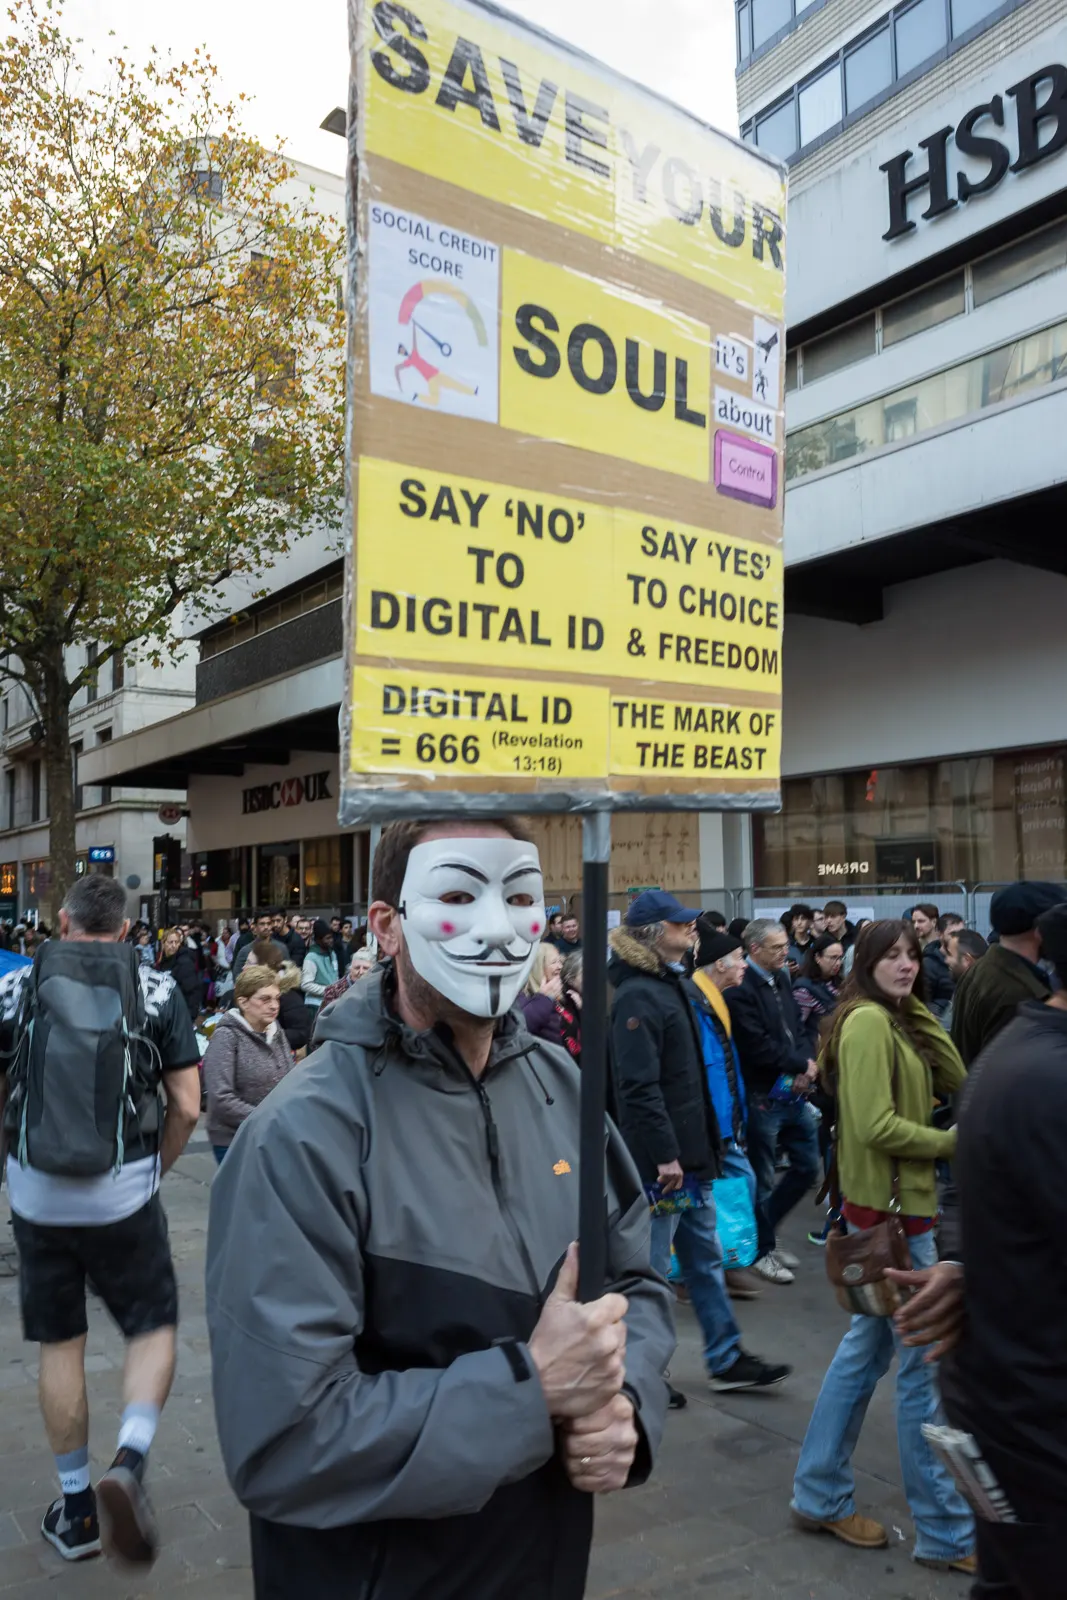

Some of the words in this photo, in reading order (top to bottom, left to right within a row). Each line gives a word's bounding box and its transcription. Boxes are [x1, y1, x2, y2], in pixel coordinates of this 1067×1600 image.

[371, 1, 611, 178] SAVE
[615, 125, 785, 272] YOUR
[372, 206, 434, 243] SOCIAL
[439, 229, 496, 262] CREDIT
[408, 248, 463, 280] SCORE
[512, 303, 706, 429] SOUL
[718, 396, 772, 436] about
[728, 458, 766, 483] Control
[399, 478, 490, 529] SAY
[640, 526, 698, 565] SAY
[467, 546, 525, 590] TO
[370, 590, 552, 647] DIGITAL
[568, 615, 605, 652] ID
[627, 573, 667, 609] TO
[679, 584, 778, 630] CHOICE
[626, 627, 646, 657] &
[659, 633, 779, 675] FREEDOM
[382, 685, 529, 724] DIGITAL
[541, 696, 573, 725] ID
[613, 702, 665, 729] THE
[674, 706, 741, 735] MARK
[749, 712, 776, 737] OF
[381, 736, 400, 756] =
[415, 733, 480, 764] 666
[491, 730, 583, 749] (Revelation
[636, 742, 684, 768] THE
[694, 744, 767, 770] BEAST
[513, 756, 563, 775] 13:18)
[303, 770, 333, 802] UK
